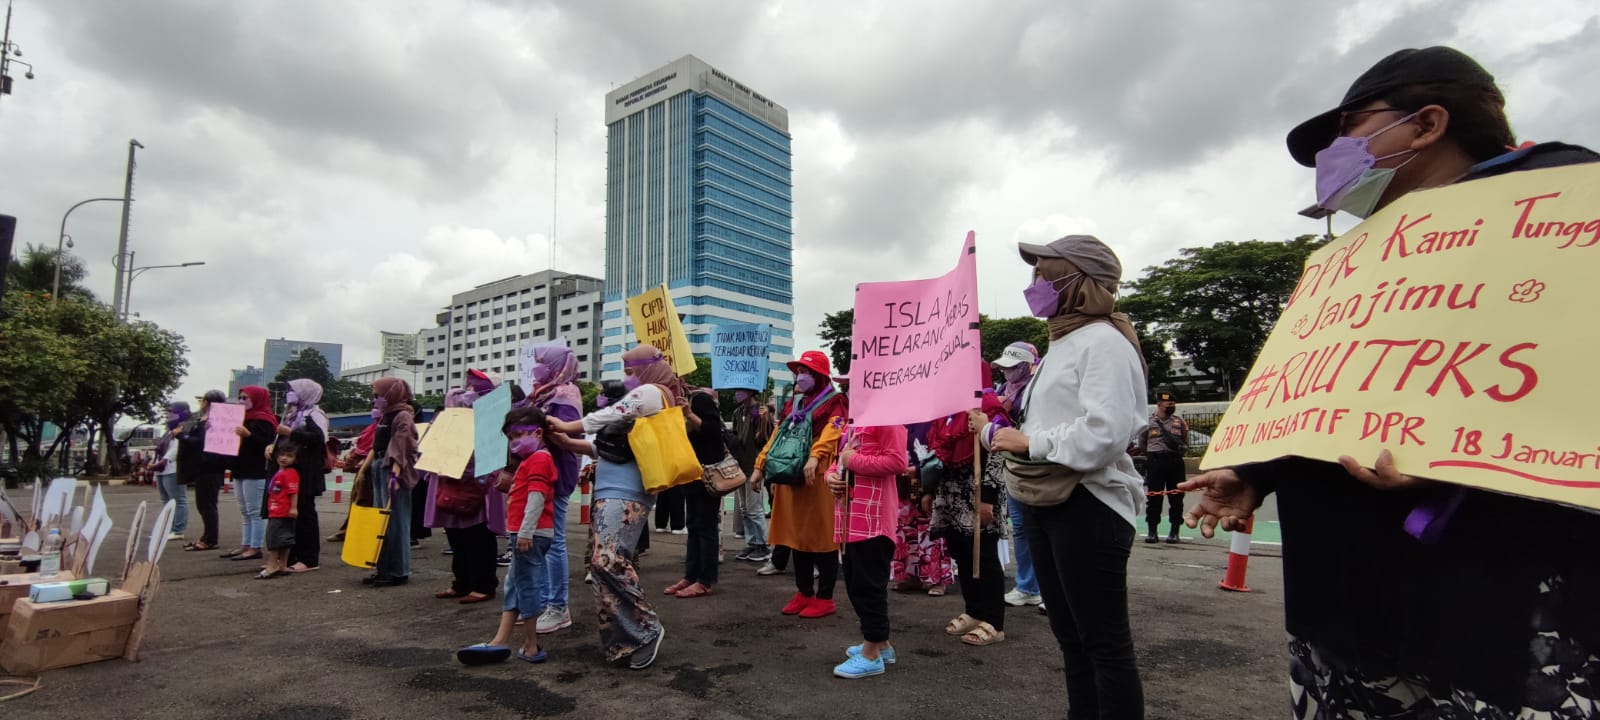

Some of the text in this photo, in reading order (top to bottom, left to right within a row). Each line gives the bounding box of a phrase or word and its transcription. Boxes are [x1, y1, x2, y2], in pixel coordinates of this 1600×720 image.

[1285, 232, 1369, 312] DPR
[1380, 213, 1484, 262] Kami
[1298, 277, 1485, 339] Janjimu
[723, 359, 759, 373] SEKSUAL
[863, 329, 970, 390] KEKERASAN SSUAL
[1215, 407, 1600, 470] JADI INISIATIF DPR 18 Januari
